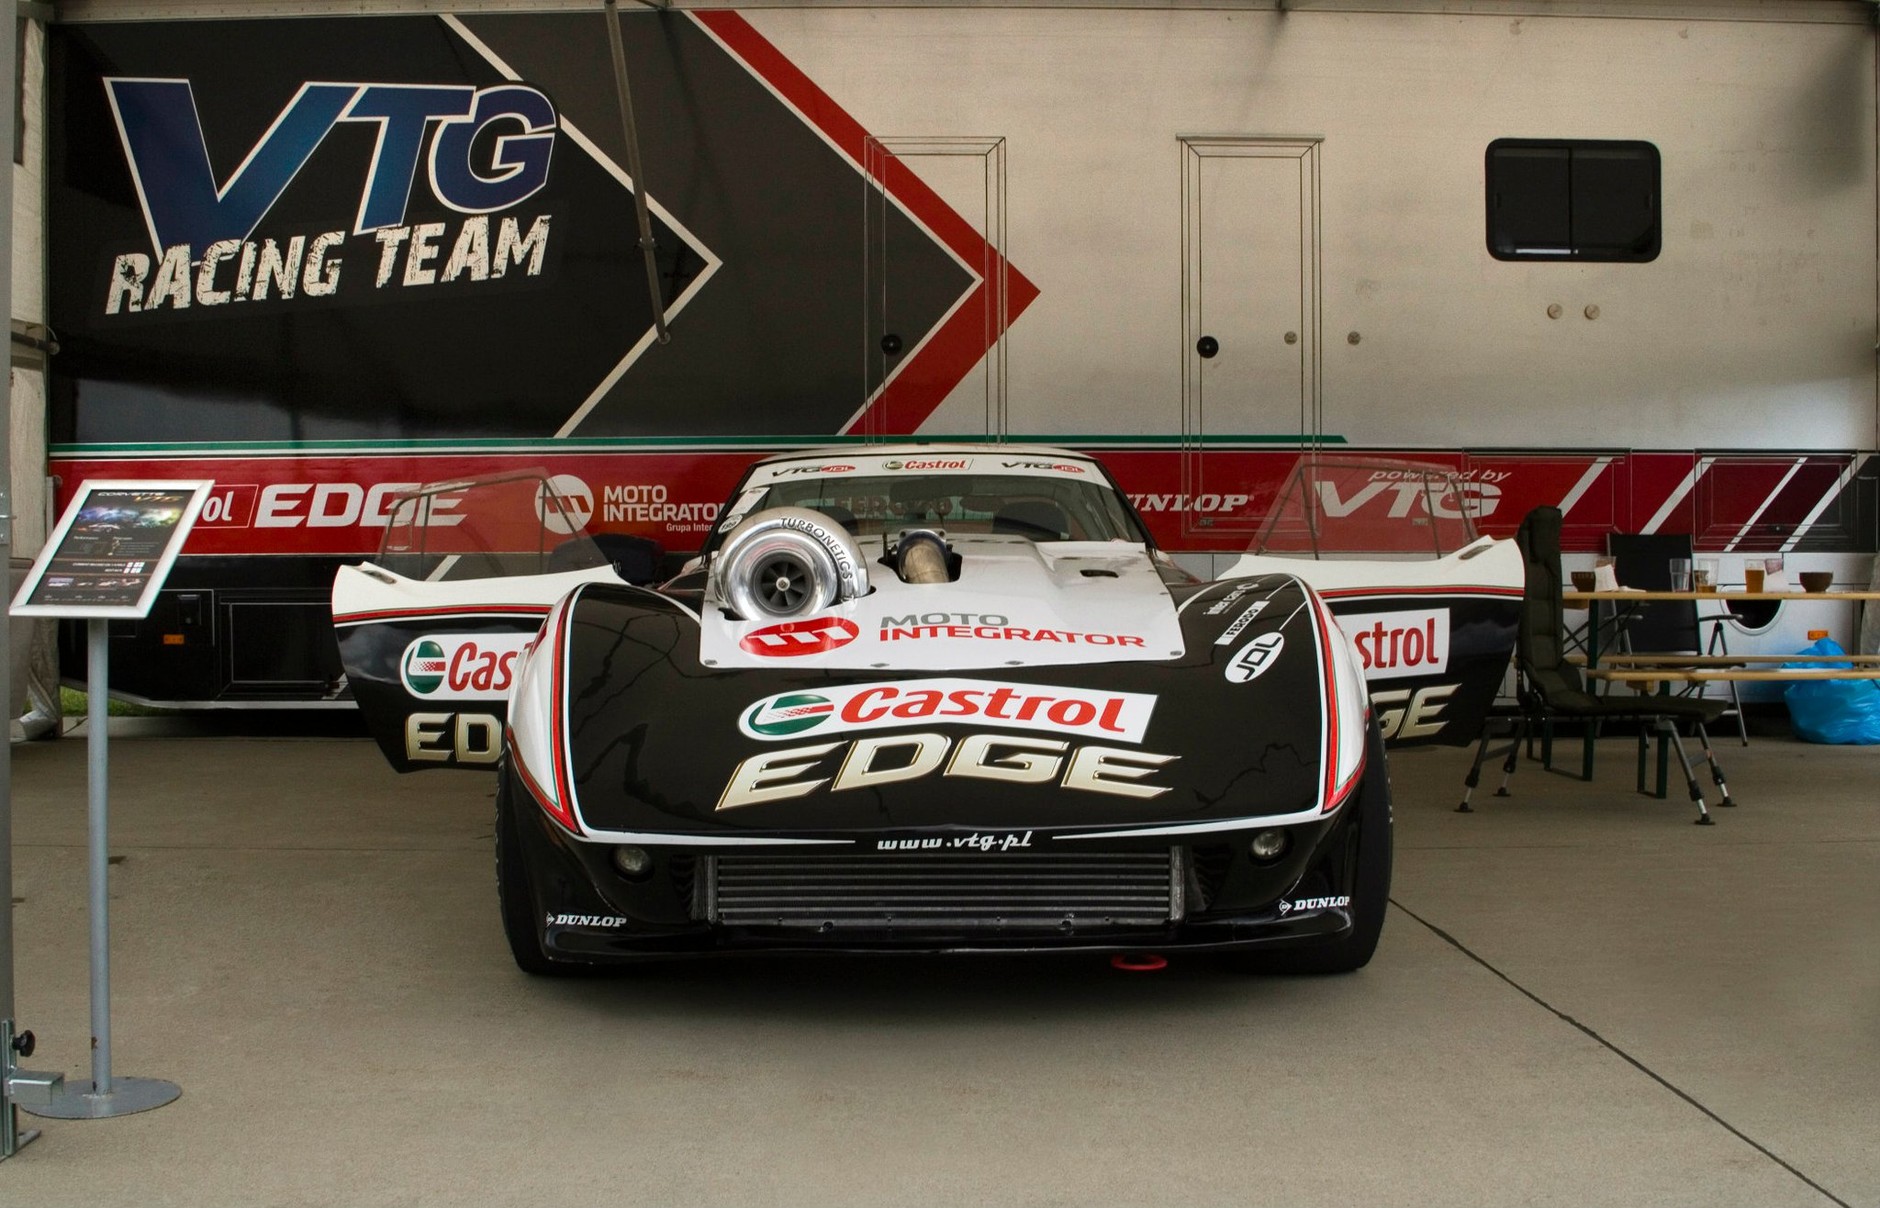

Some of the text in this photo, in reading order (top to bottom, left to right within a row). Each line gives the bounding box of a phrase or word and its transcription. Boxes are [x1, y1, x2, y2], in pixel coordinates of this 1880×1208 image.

[103, 76, 558, 266] VTG
[105, 214, 552, 314] RACING TEAM
[904, 459, 967, 470] Castrol
[1481, 469, 1512, 483] by
[254, 482, 473, 528] EDGE
[603, 485, 668, 503] MOTO
[1314, 481, 1502, 519] VTG
[666, 523, 691, 533] Grupa
[781, 518, 854, 580] TURBONETICS
[881, 613, 1009, 628] MOTO
[880, 625, 1148, 648] INTEGRATOR
[840, 687, 1126, 733] Castrol
[715, 733, 1182, 811] EDGE
[877, 830, 1034, 851] www.vtg.pl
[1293, 896, 1351, 911] DUNLOP
[555, 914, 628, 928] DUNLOP
